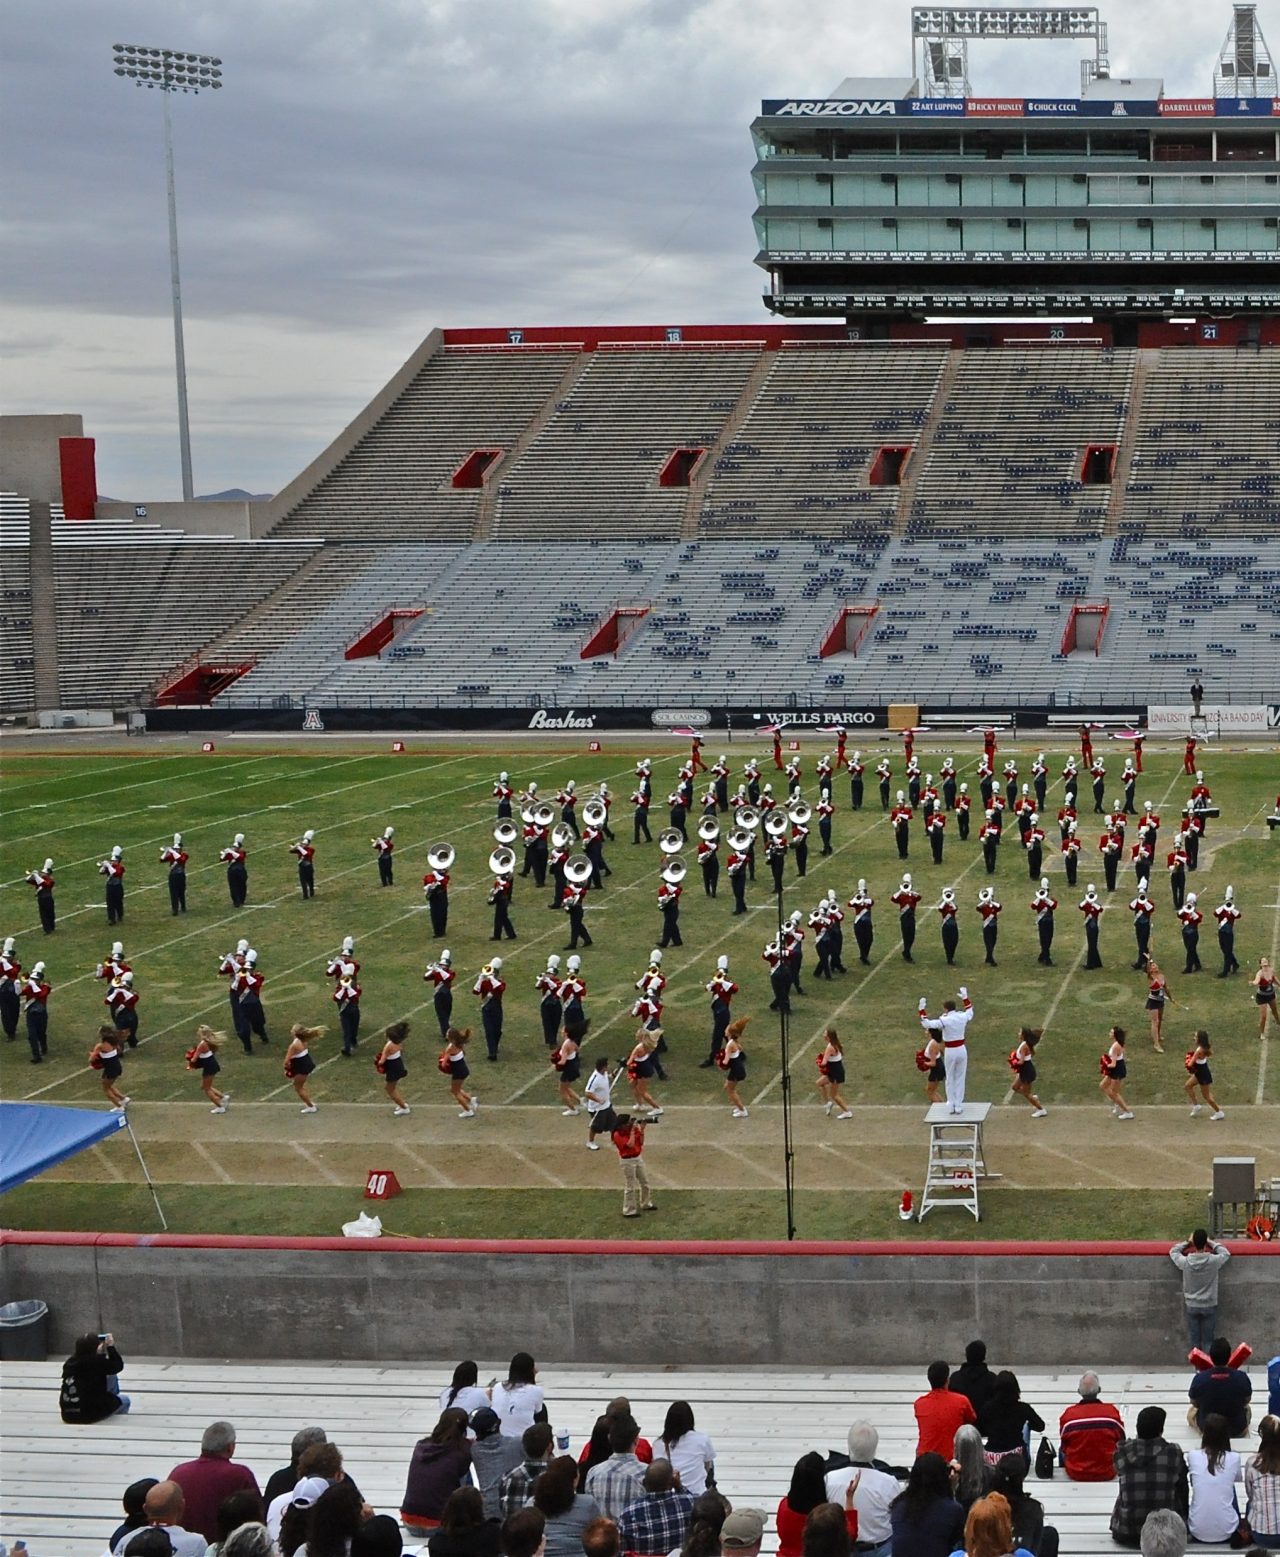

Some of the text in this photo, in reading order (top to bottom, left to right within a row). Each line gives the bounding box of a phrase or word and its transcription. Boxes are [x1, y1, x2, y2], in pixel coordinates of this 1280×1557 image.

[775, 102, 896, 116] ARIZONA
[920, 102, 934, 111] ART
[935, 102, 963, 111] LUPPINO
[977, 102, 993, 111] RICKY
[994, 102, 1023, 111] HUNLEY
[1034, 103, 1057, 111] CHUCK
[1059, 103, 1077, 111] CECIL
[1194, 103, 1214, 112] LEWIS
[668, 333, 680, 342] 18
[1050, 330, 1064, 339] 20
[1204, 329, 1216, 338] 21
[510, 334, 521, 344] 17
[136, 507, 147, 516] 16
[528, 709, 597, 729] Bashas'
[767, 712, 875, 724] WELLS FARGO
[1150, 712, 1187, 723] UNIVERSITY
[1230, 713, 1249, 722] BAND
[1250, 713, 1263, 722] DAY
[367, 1174, 388, 1195] 40
